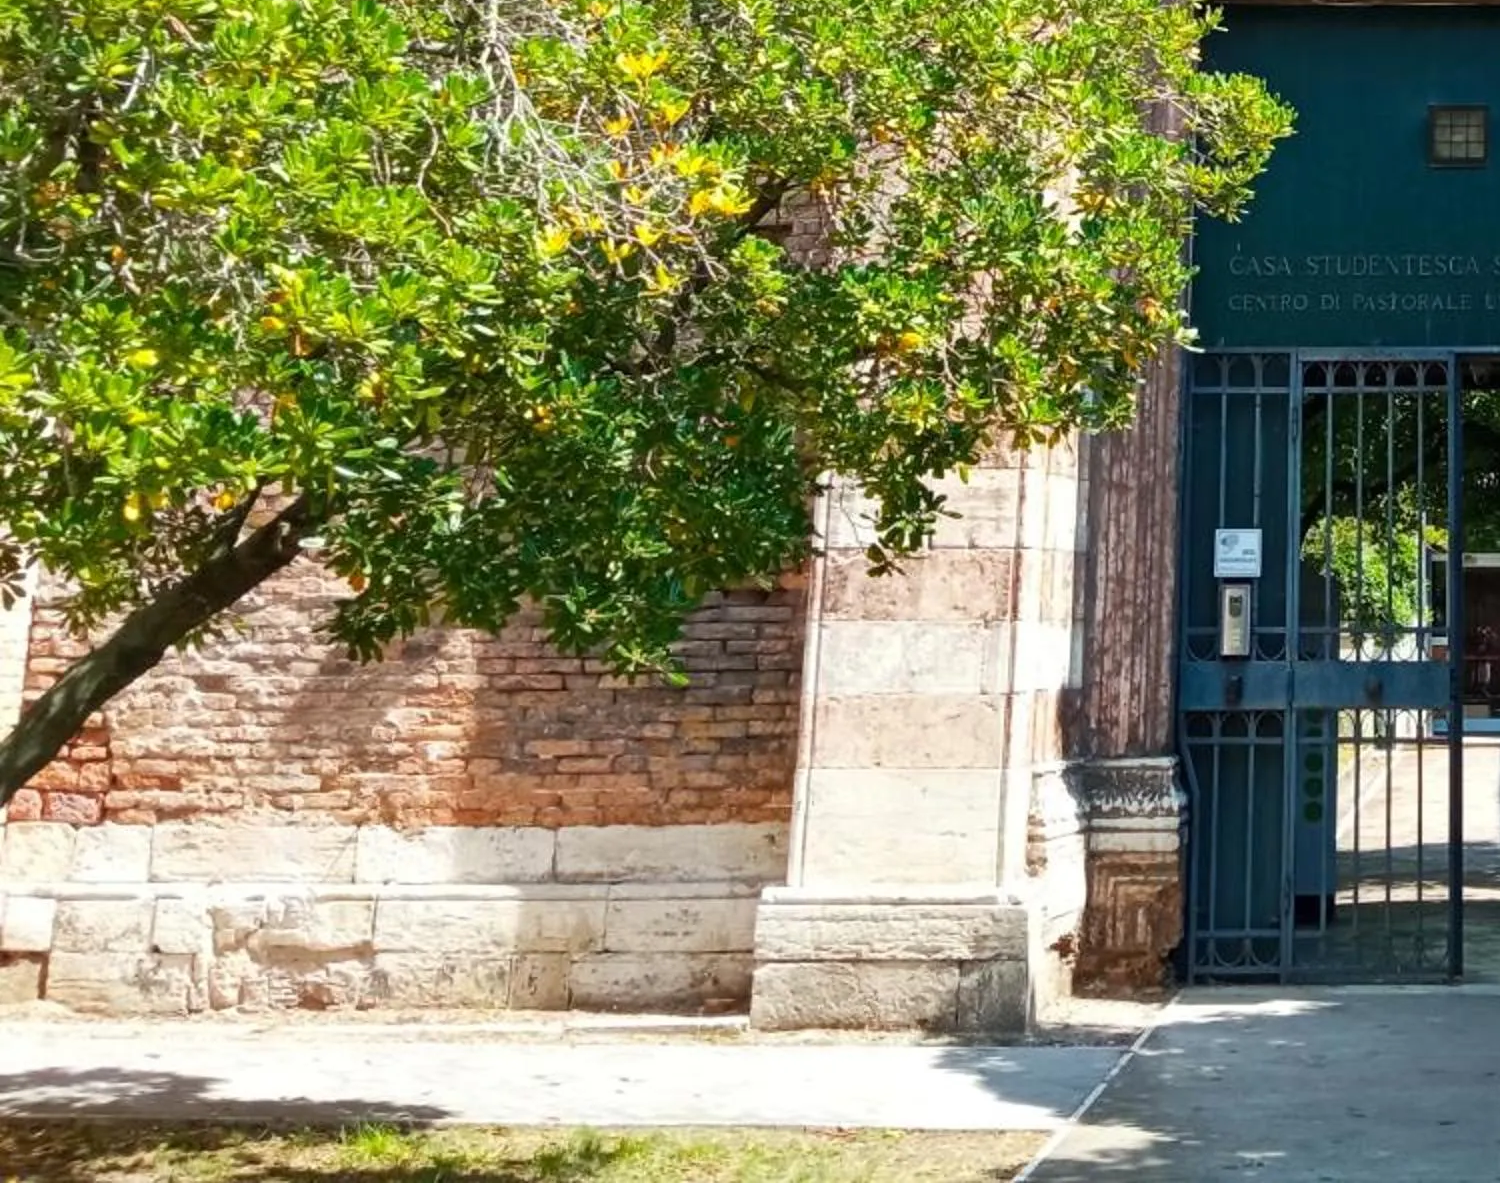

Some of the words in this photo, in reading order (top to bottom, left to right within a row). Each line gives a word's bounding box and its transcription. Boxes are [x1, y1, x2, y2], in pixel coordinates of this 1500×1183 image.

[1228, 255, 1291, 275] CASA
[1306, 255, 1480, 275] STUDENTESCA
[1228, 293, 1309, 312] CENTRO
[1320, 293, 1341, 311] DI
[1352, 292, 1472, 312] PASTORALE
